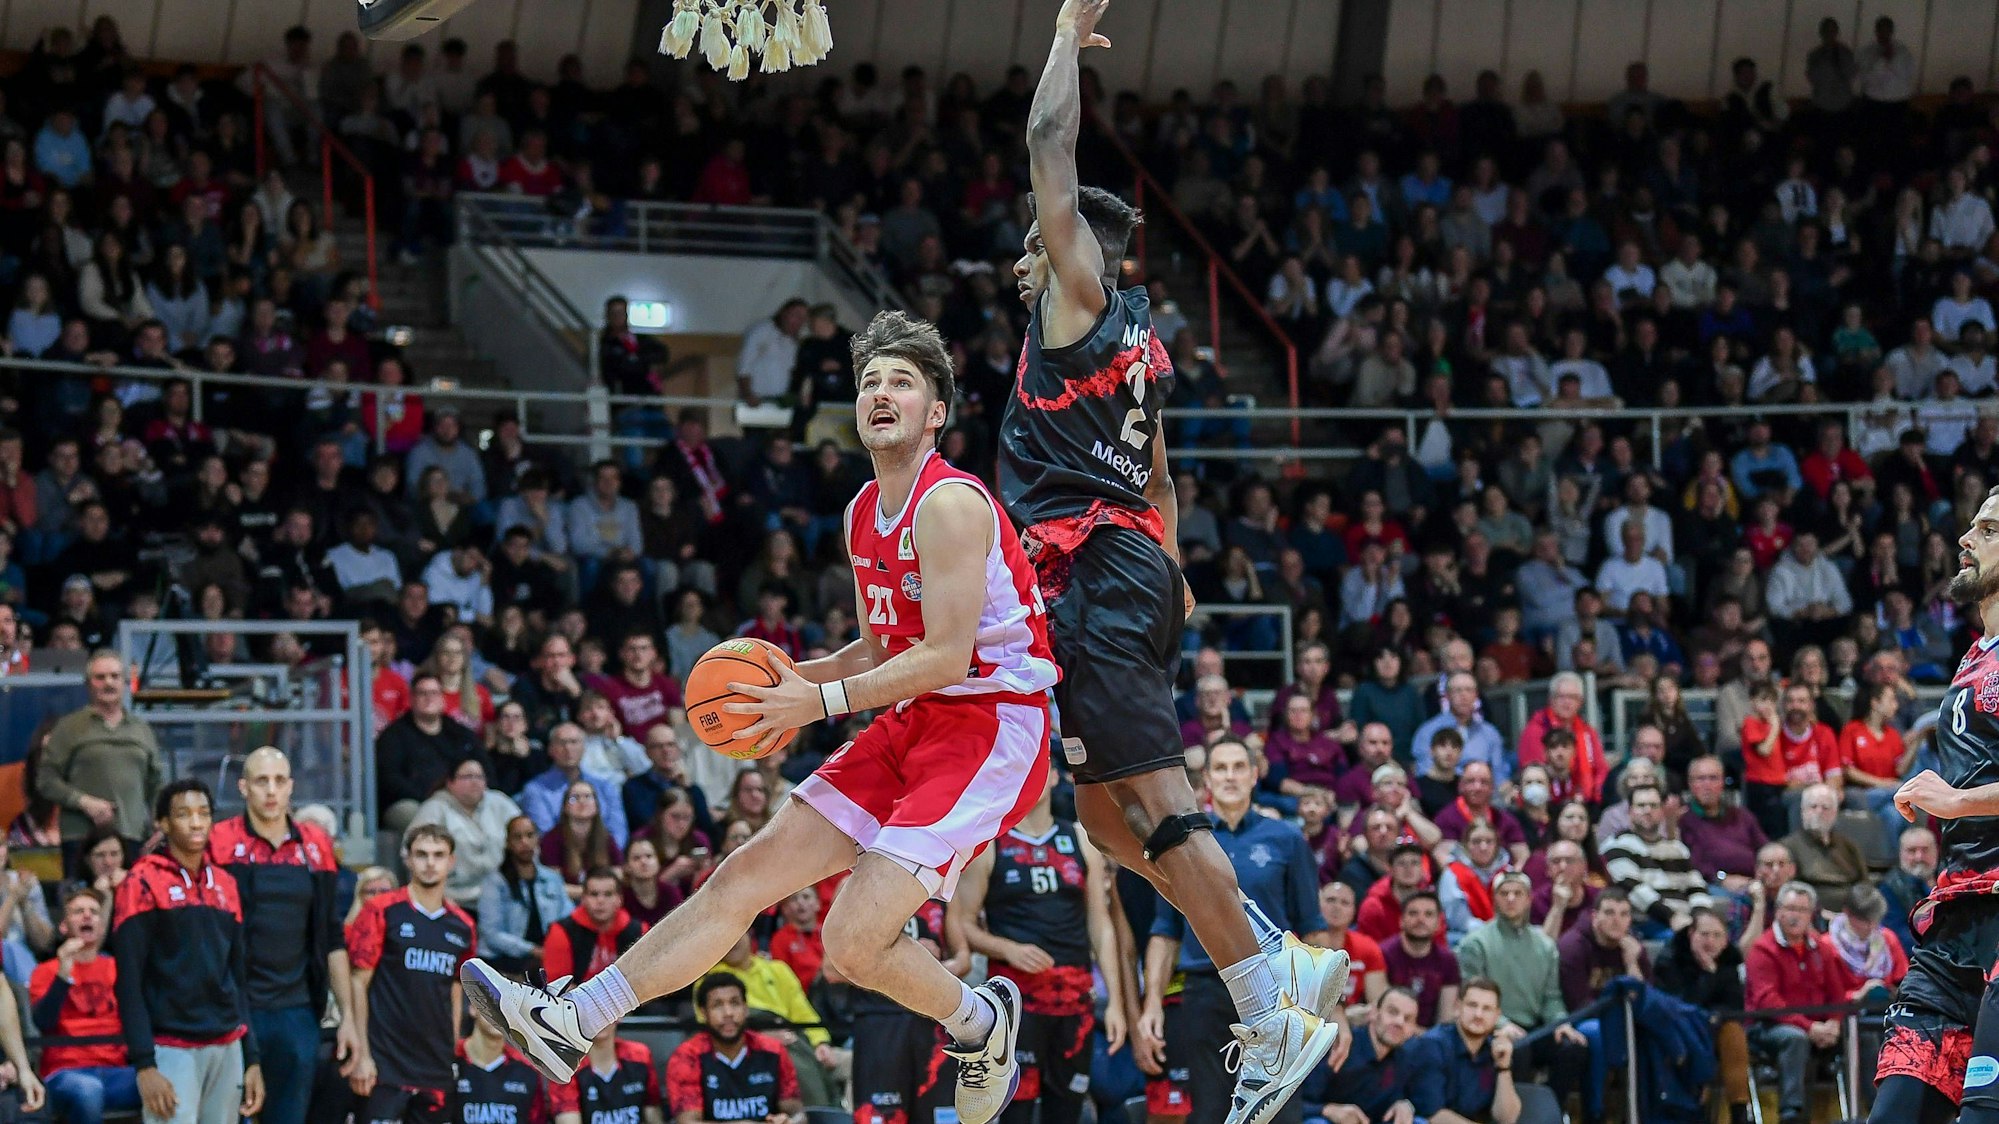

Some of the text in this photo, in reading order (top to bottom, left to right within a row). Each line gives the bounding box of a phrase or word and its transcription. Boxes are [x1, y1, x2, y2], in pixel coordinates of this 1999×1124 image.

[866, 583, 898, 626] 27
[699, 711, 720, 728] FIBA
[1952, 688, 1967, 736] 8
[1030, 866, 1058, 894] 51
[404, 947, 457, 977] GIANTS
[463, 1102, 517, 1124] GIANTS
[591, 1106, 640, 1124] GIANTS
[713, 1095, 769, 1120] GIANTS
